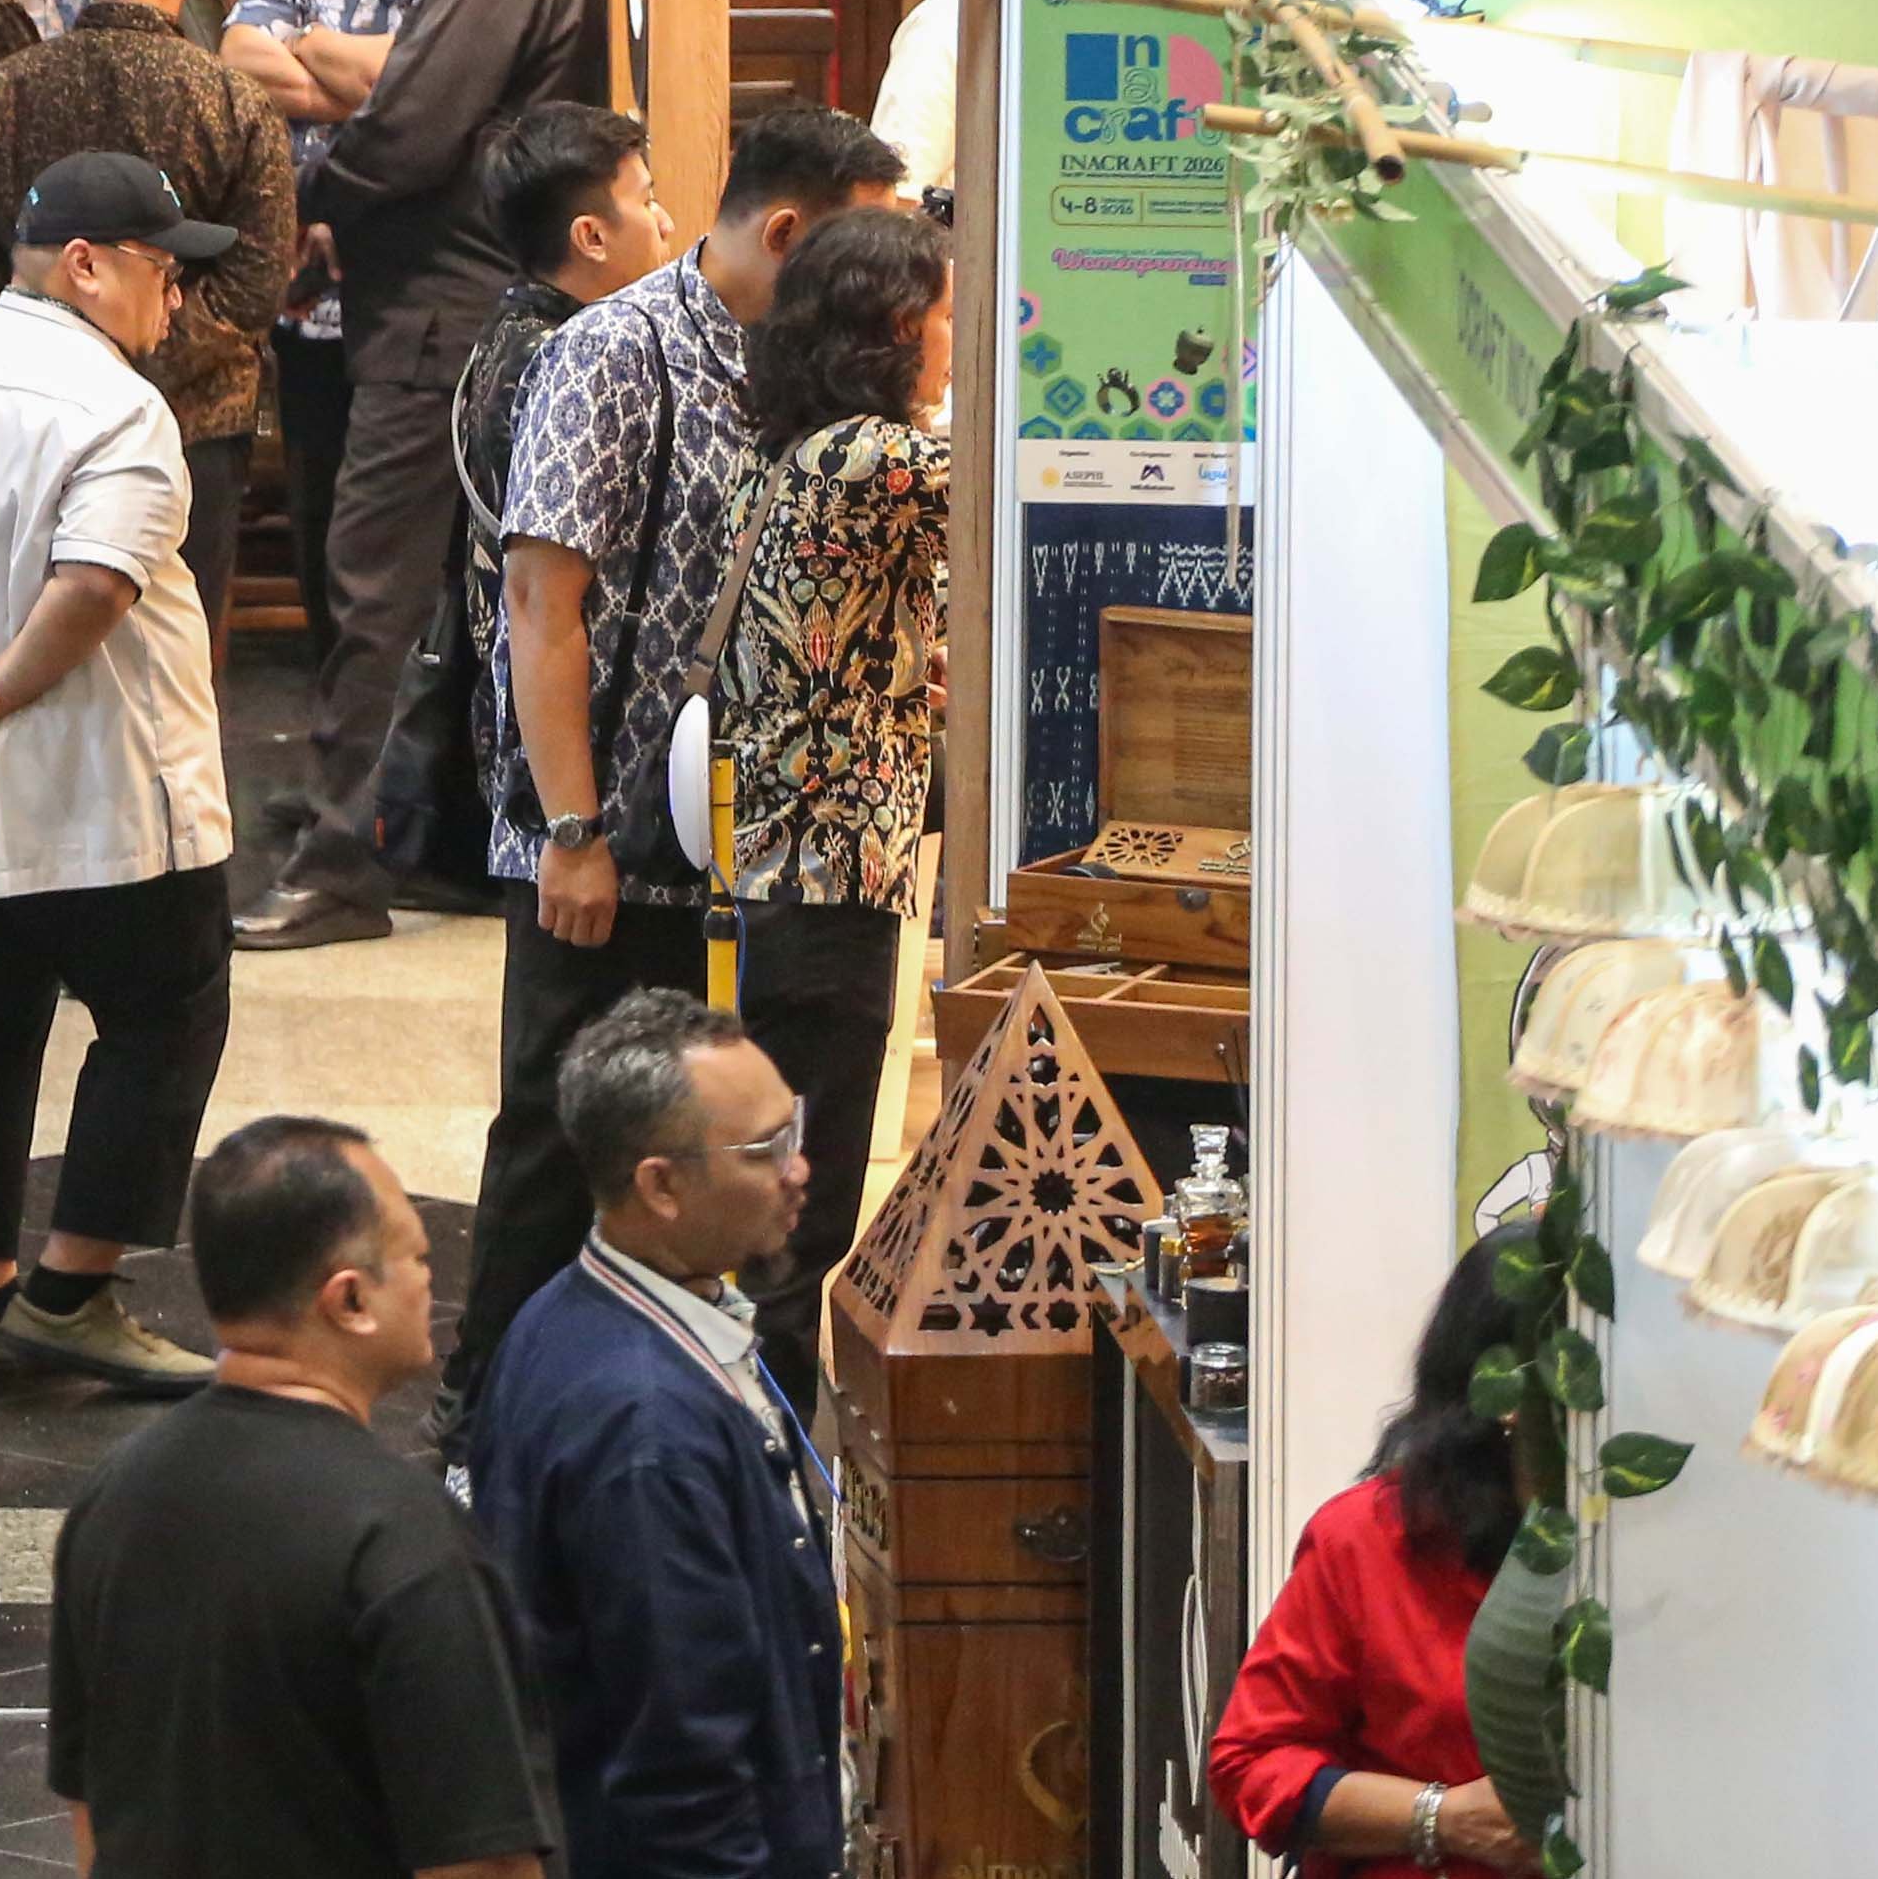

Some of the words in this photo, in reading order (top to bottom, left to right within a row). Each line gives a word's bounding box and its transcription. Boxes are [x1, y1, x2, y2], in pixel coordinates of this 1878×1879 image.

[1060, 154, 1178, 172] INACRAFT
[1183, 157, 1226, 173] 2026
[1060, 195, 1098, 215] 4-8
